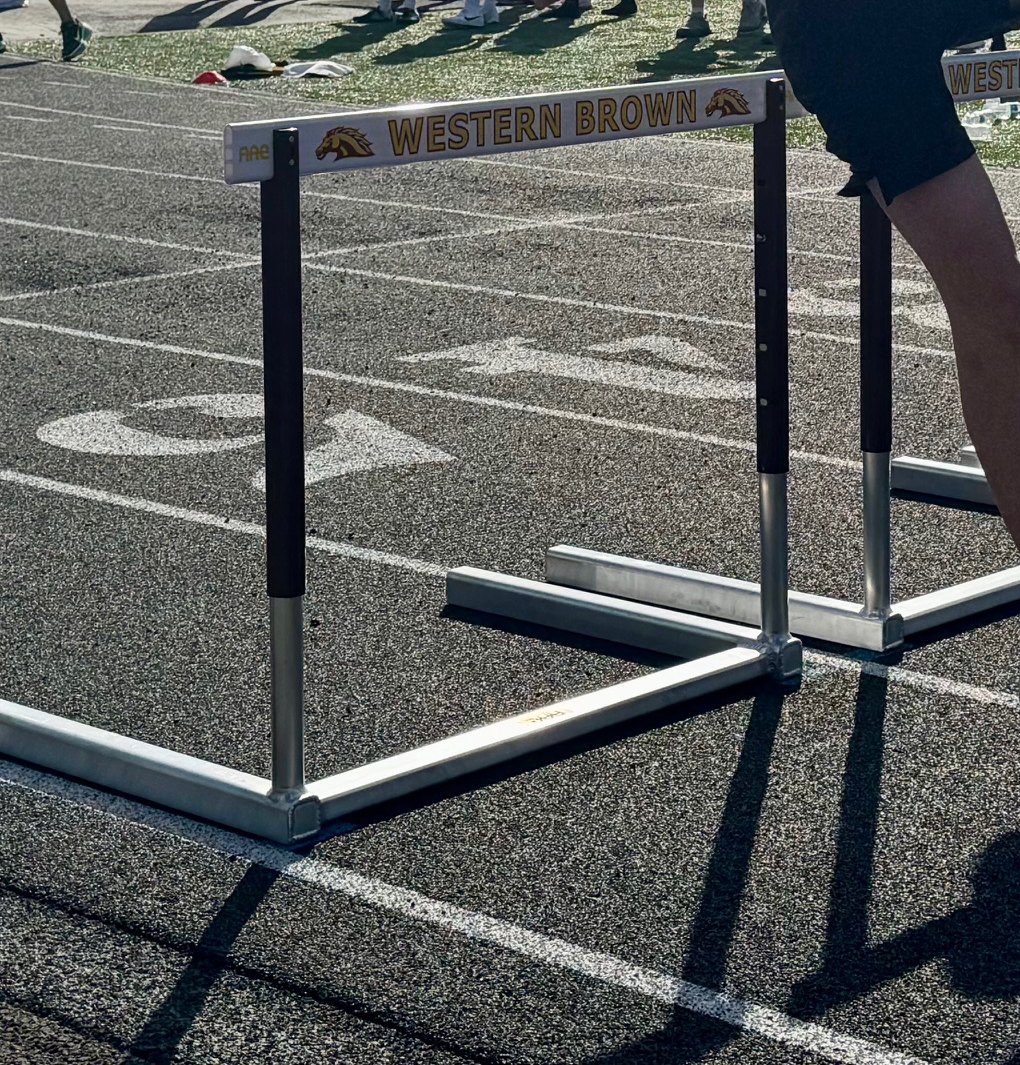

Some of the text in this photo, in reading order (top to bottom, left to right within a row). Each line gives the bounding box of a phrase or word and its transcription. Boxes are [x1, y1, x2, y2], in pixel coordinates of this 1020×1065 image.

[387, 89, 698, 156] WESTERN BROWN
[35, 392, 458, 491] 5
